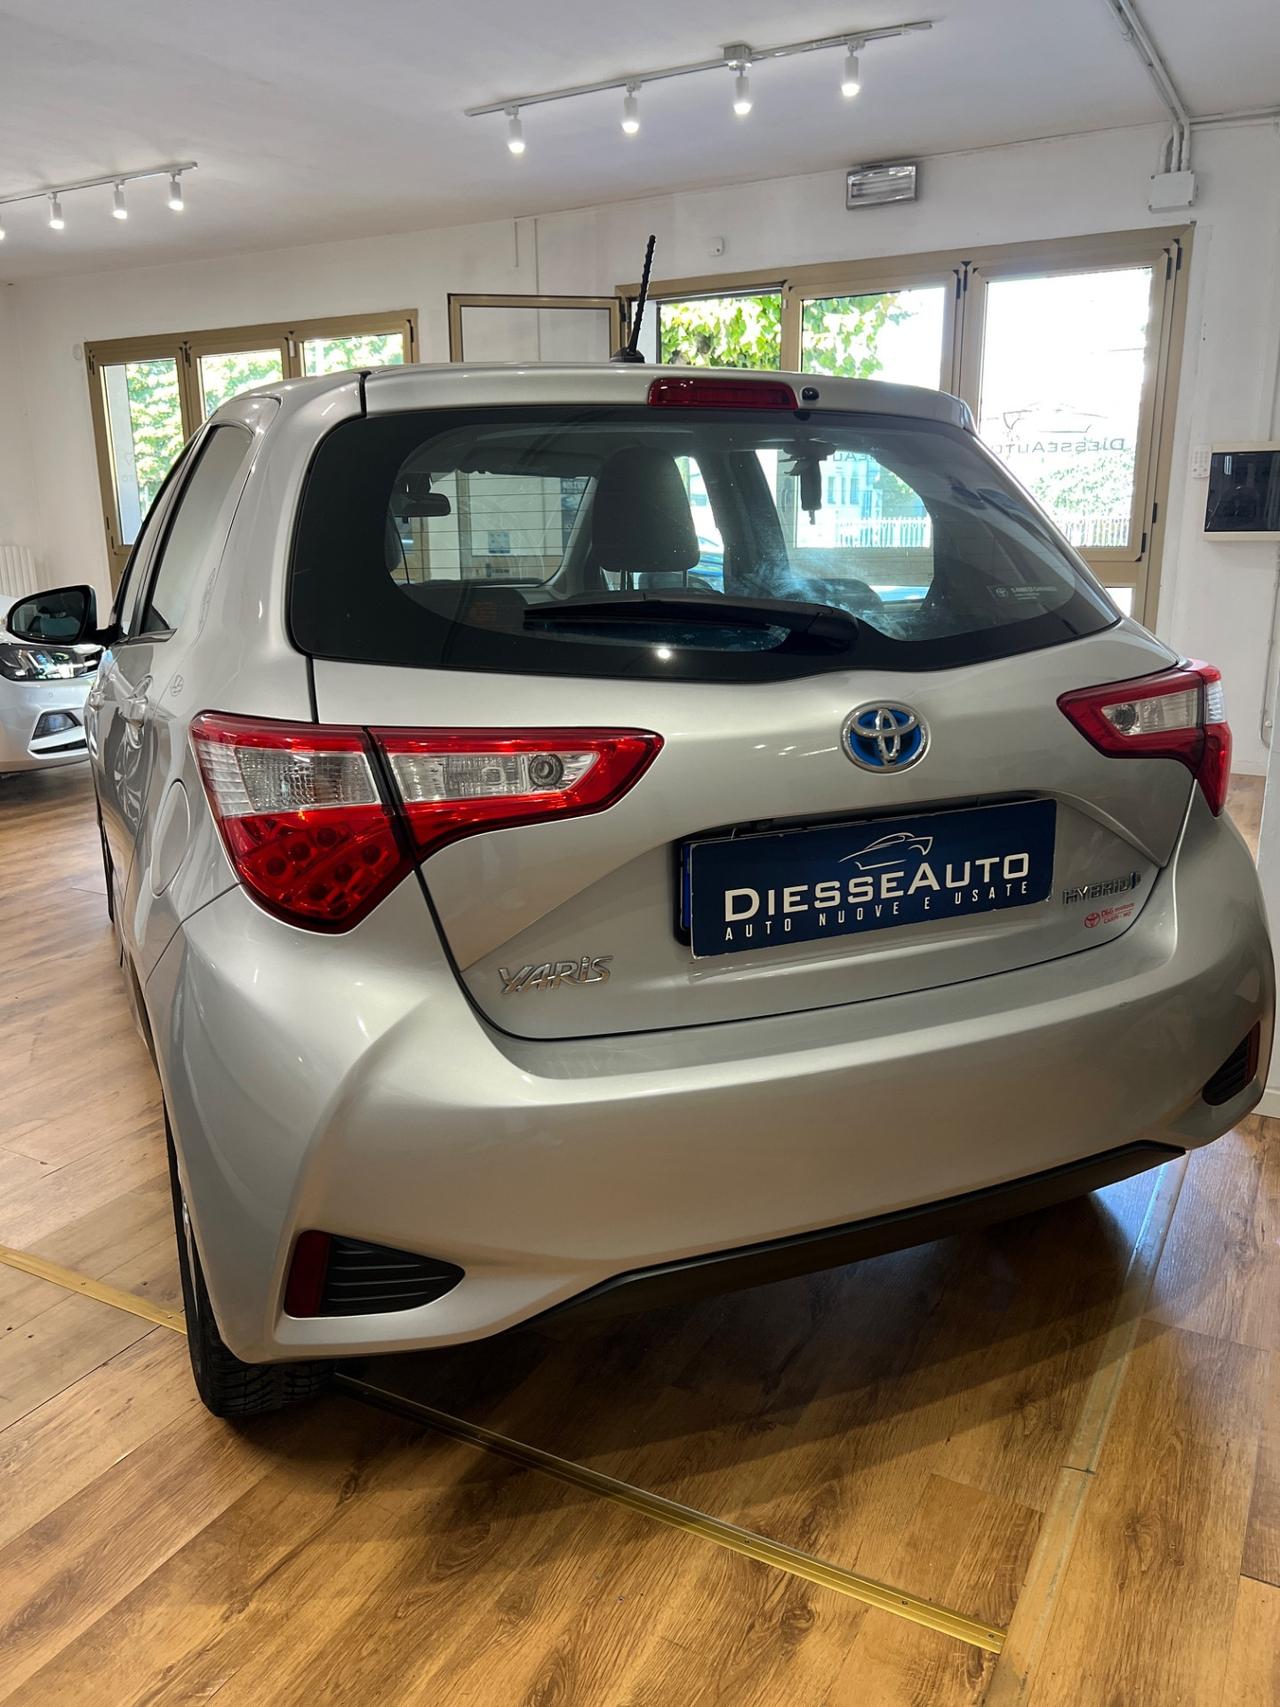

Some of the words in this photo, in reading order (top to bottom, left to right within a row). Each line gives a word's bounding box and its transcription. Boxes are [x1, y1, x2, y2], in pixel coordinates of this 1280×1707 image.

[725, 853, 1029, 922] DIESSEAUTO
[725, 918, 792, 941] AUTO
[818, 902, 899, 926] NUOVE
[924, 897, 931, 910] E
[954, 881, 1028, 905] USATE
[1063, 880, 1130, 904] HYBRID
